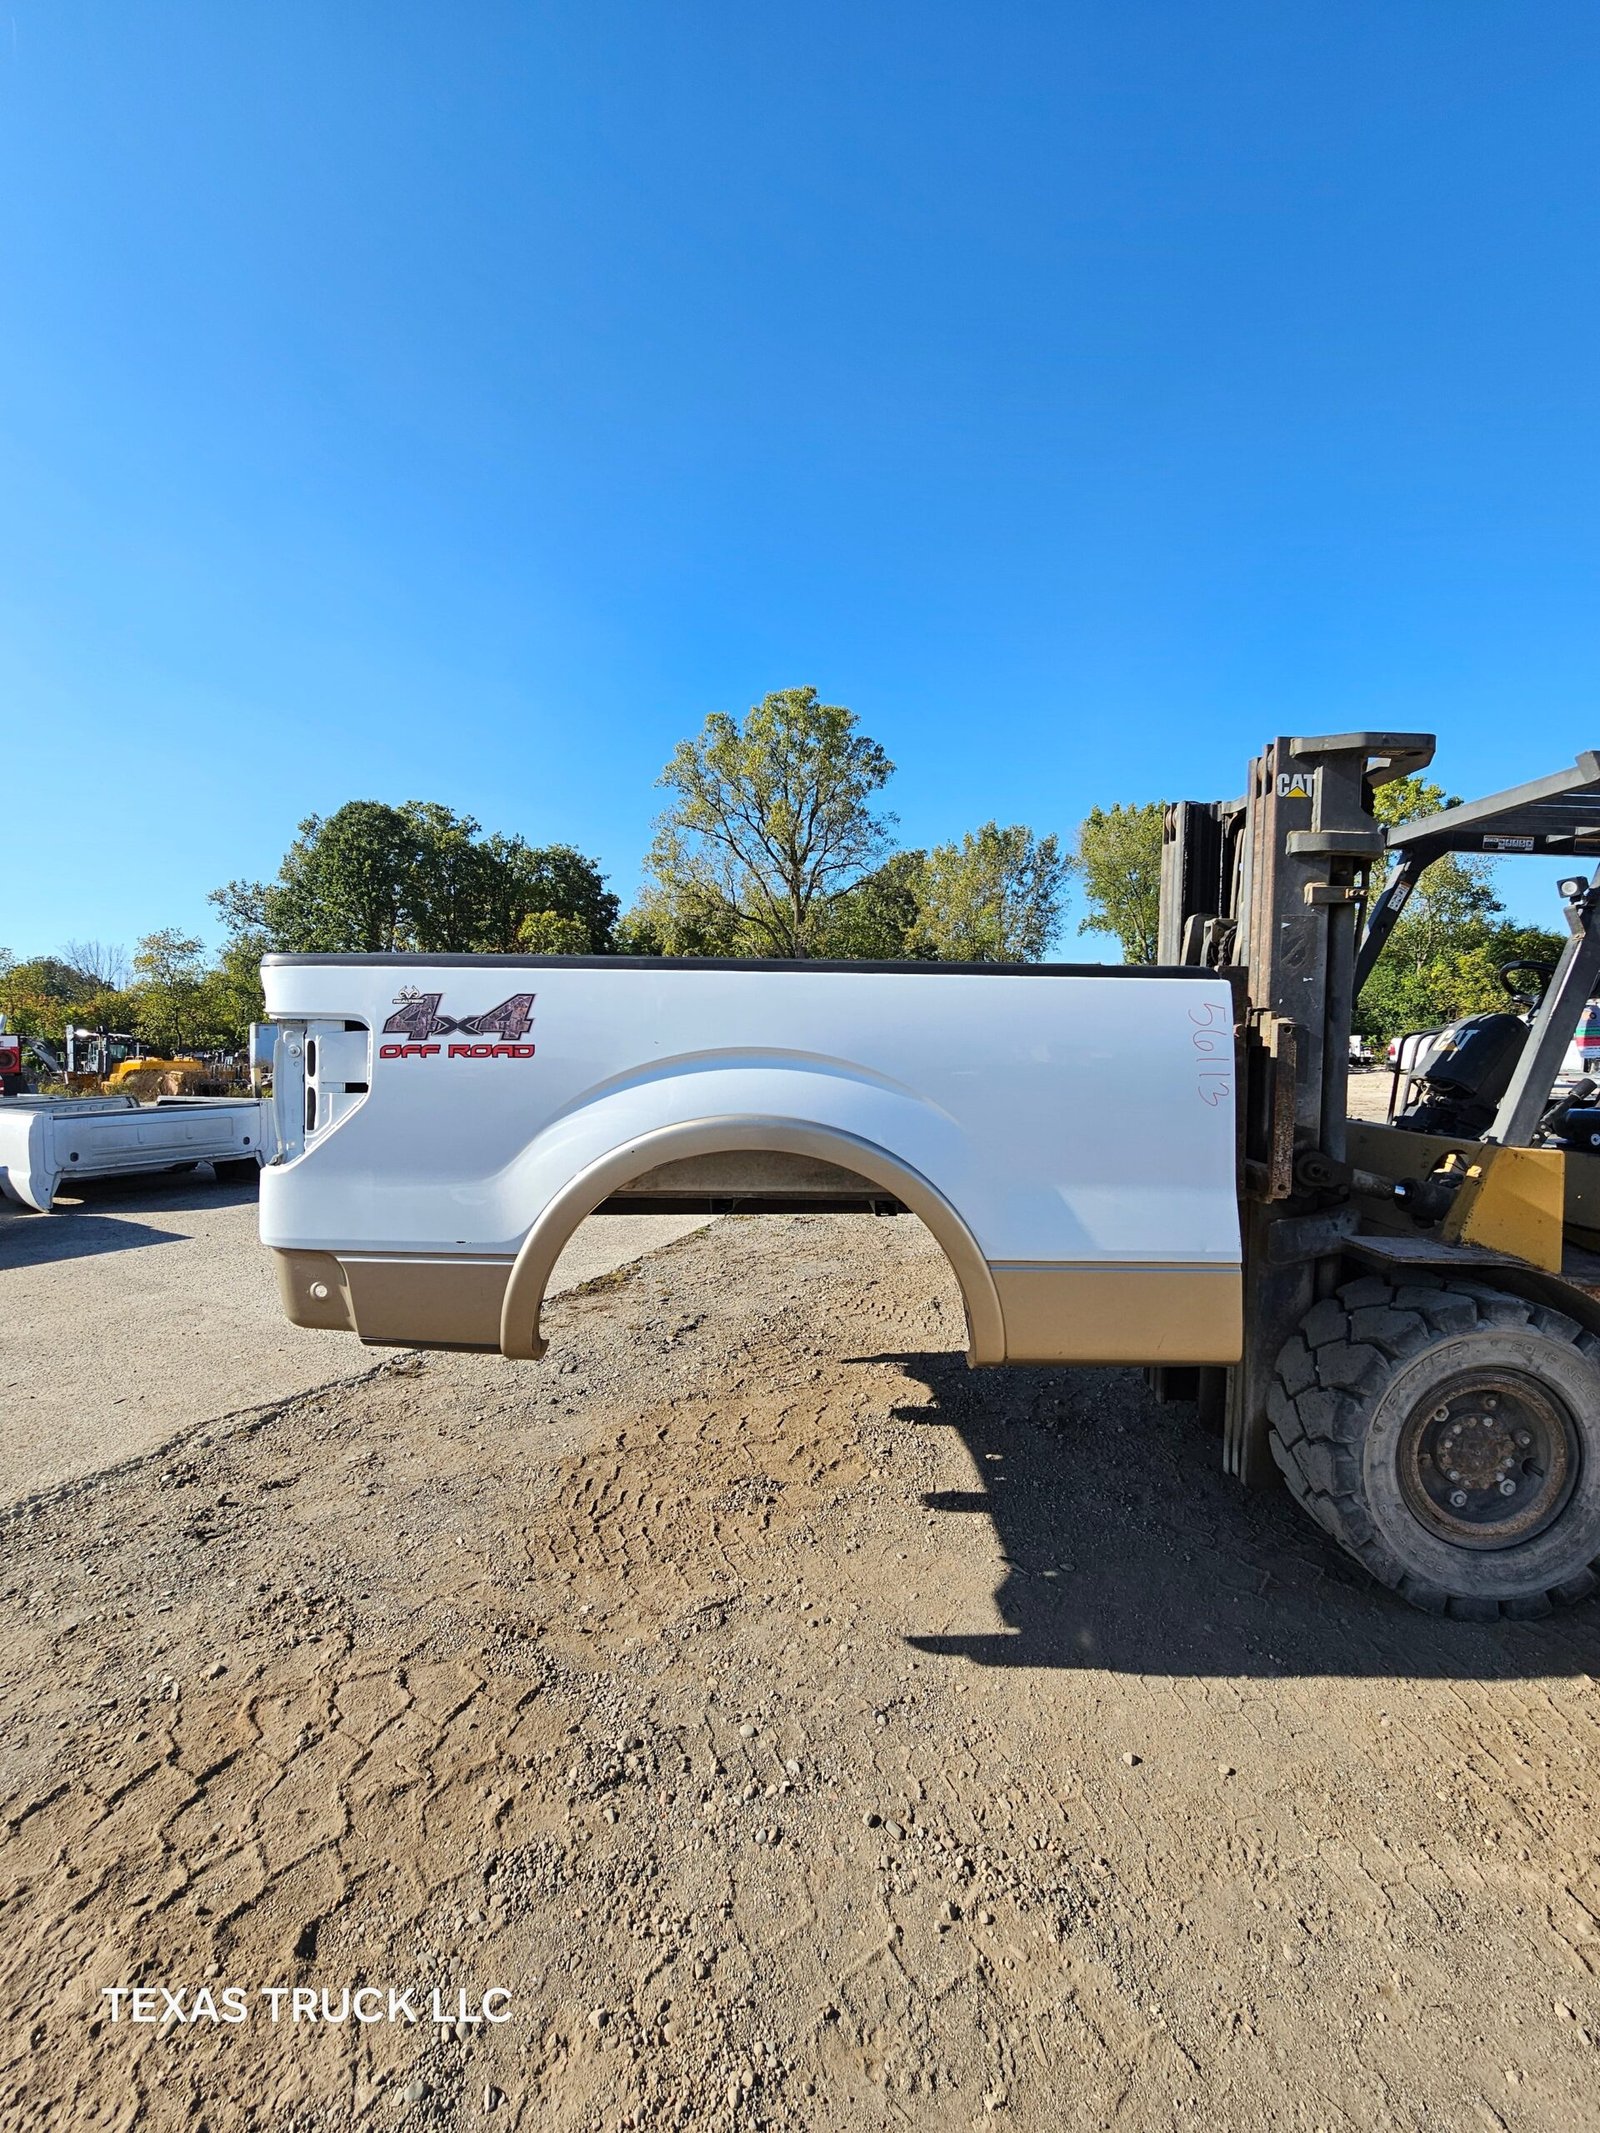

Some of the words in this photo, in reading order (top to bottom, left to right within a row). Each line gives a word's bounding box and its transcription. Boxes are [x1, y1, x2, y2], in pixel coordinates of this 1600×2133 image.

[1276, 773, 1315, 798] CAT
[380, 1044, 441, 1059] OFF
[448, 1044, 535, 1059] ROAD
[1187, 1002, 1231, 1107] 56113
[1432, 1029, 1480, 1062] CAT
